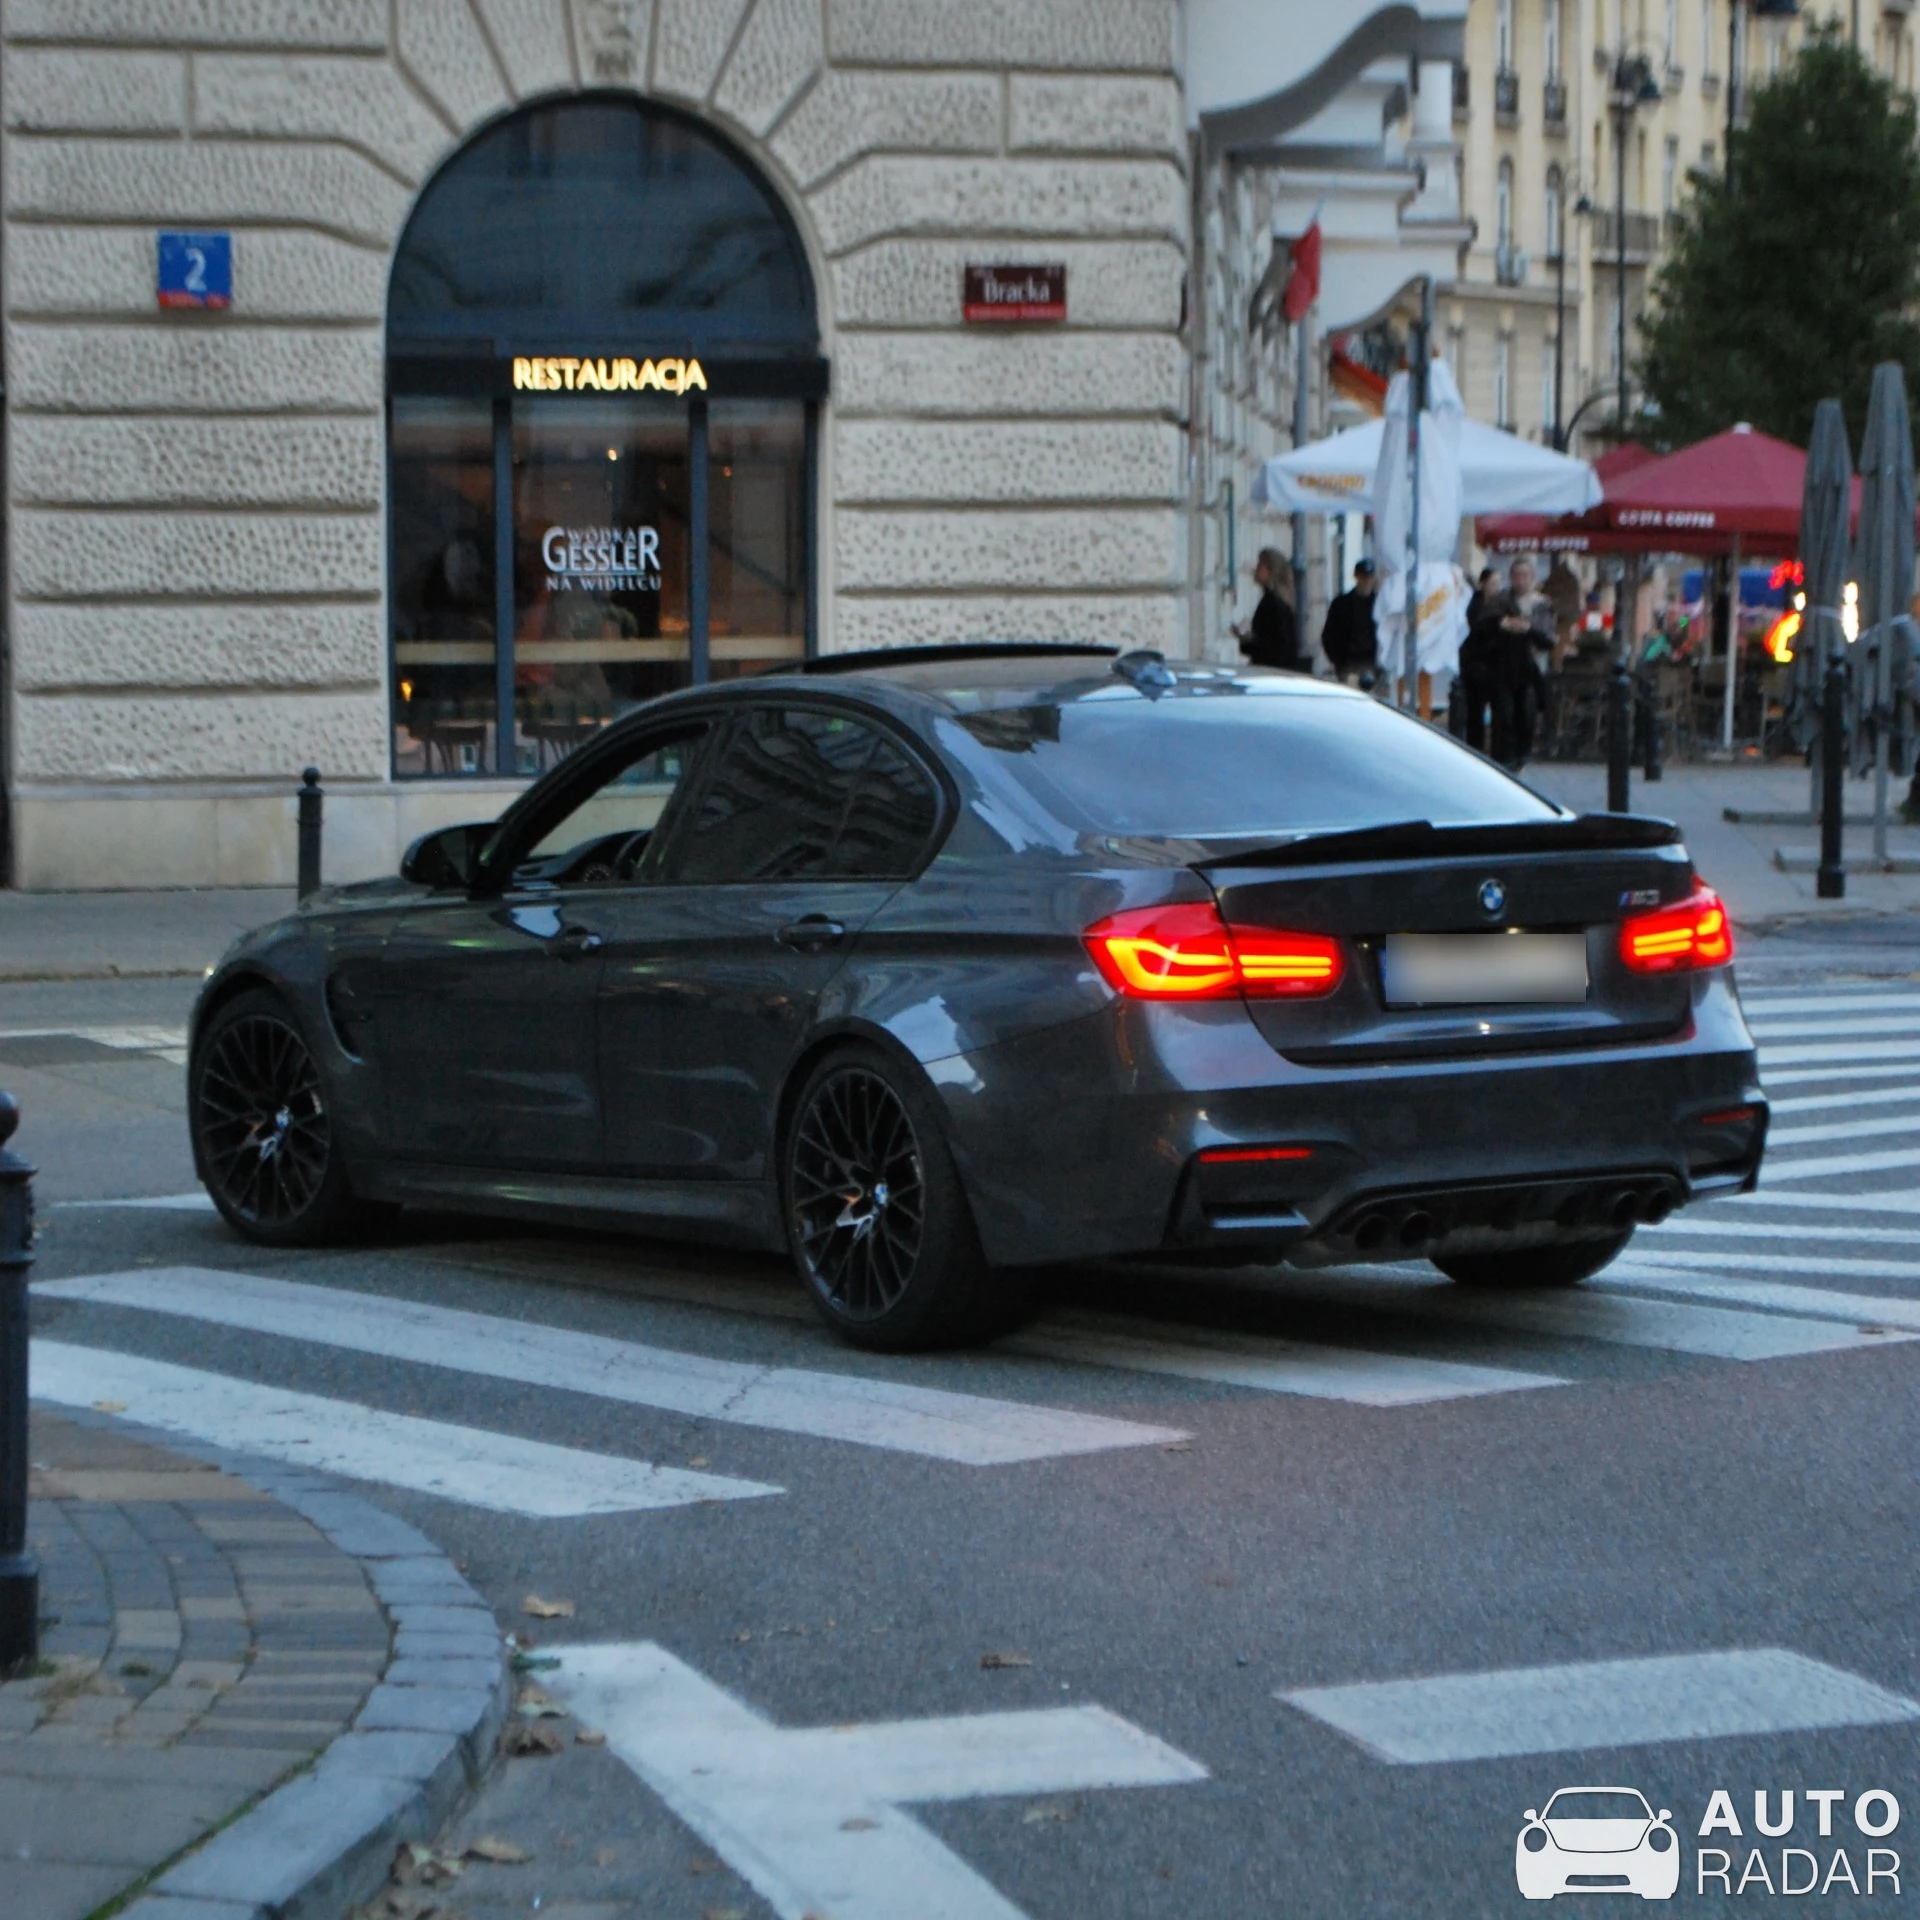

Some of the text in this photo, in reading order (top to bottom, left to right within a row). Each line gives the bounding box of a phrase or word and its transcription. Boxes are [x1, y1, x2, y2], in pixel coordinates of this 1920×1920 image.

[184, 247, 207, 292] 2
[512, 356, 708, 396] RESTAURACJA
[542, 525, 661, 573] GESSLER
[545, 576, 662, 591] NA WIDELCU
